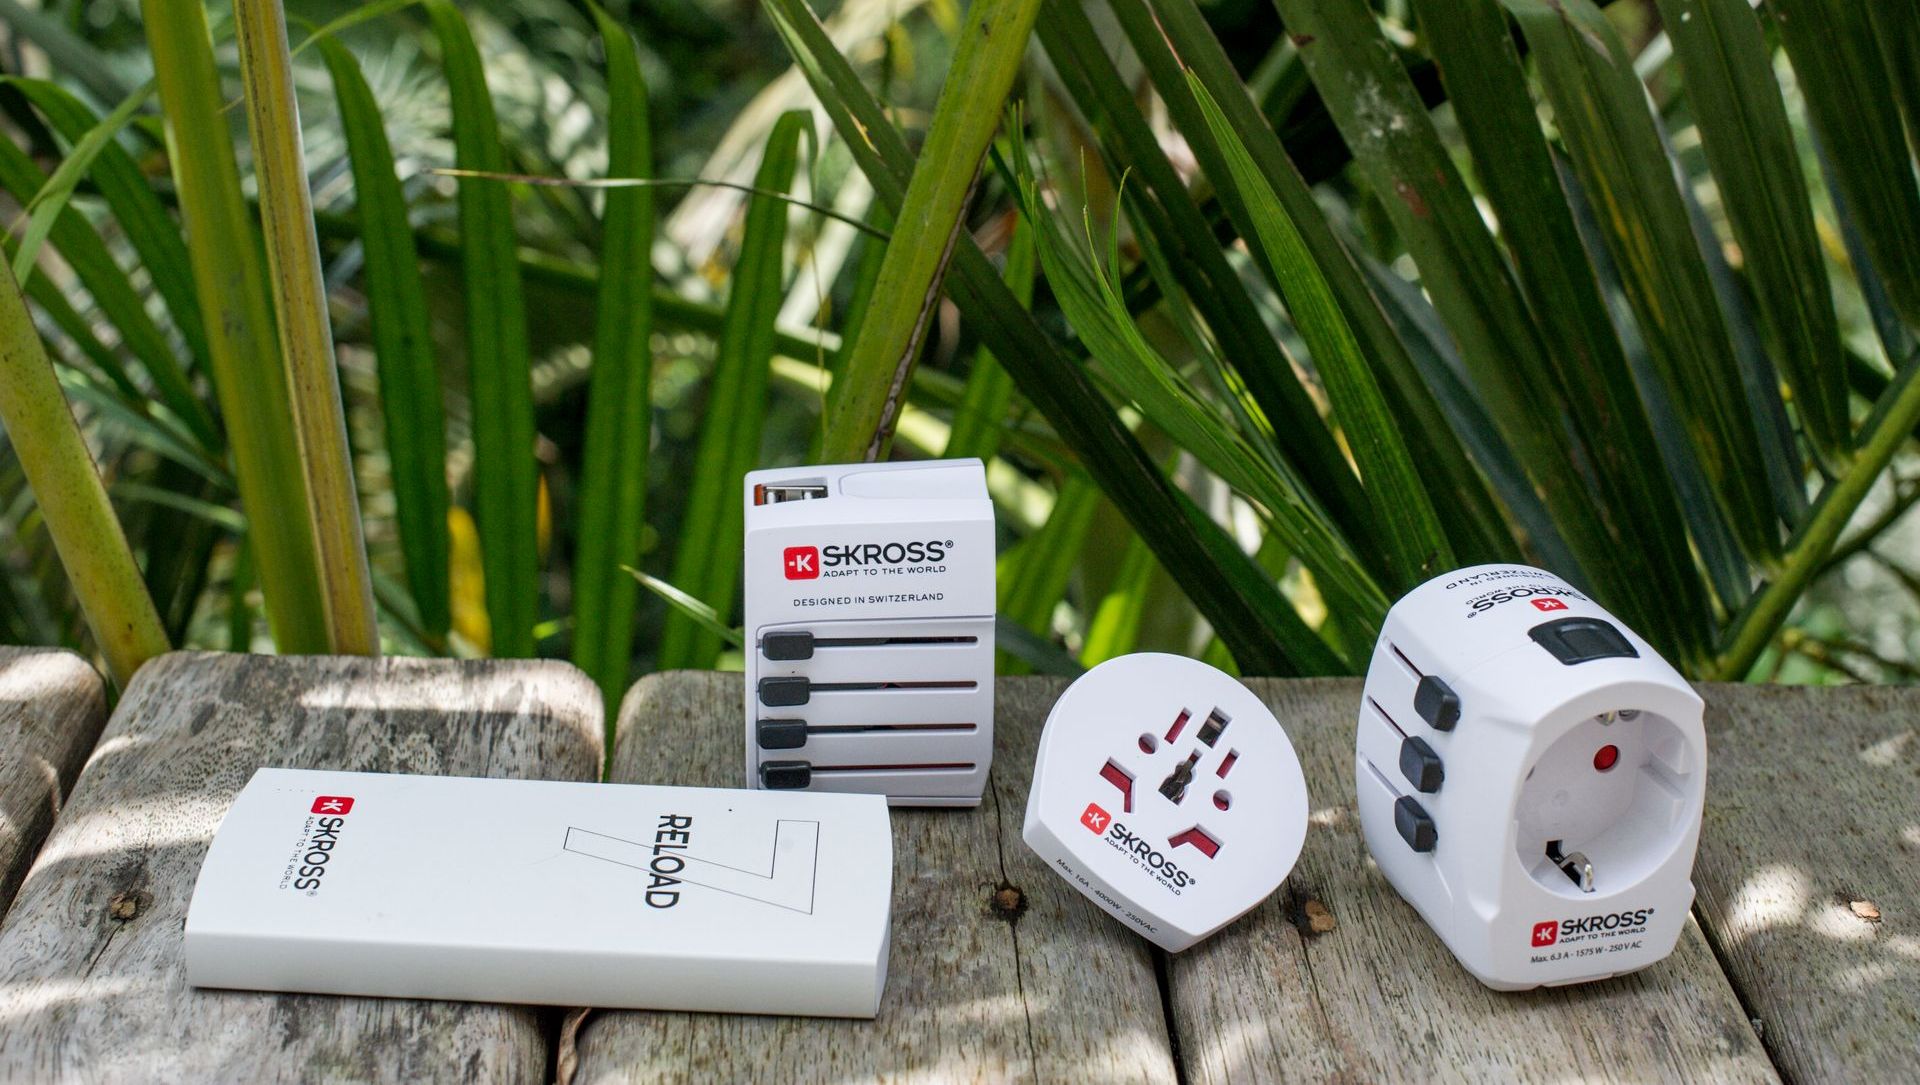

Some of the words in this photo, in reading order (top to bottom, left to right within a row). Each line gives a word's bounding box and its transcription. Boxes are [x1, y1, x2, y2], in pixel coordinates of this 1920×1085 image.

[823, 569, 859, 578] ADAPT
[863, 568, 878, 576] TO
[882, 567, 904, 575] THE
[907, 565, 947, 575] WORLD
[793, 597, 851, 607] DESIGNED
[855, 596, 865, 604] IN
[868, 593, 944, 604] SWITZERLAND
[1465, 589, 1504, 605] WORLD
[302, 816, 315, 836] ADAPT
[296, 838, 307, 848] TO
[290, 850, 302, 862] THE
[645, 814, 693, 909] RELOAD
[1104, 836, 1128, 856] ADAPT
[1129, 855, 1139, 865] TO
[1140, 864, 1156, 877] THE
[1156, 875, 1182, 896] WORLD
[279, 864, 295, 890] WORLD
[1056, 858, 1073, 875] Max.
[1075, 874, 1089, 888] 16A
[1094, 889, 1122, 910] 4000W
[1125, 911, 1159, 934] 250VAC
[1559, 935, 1585, 944] ADAPT
[1618, 927, 1646, 936] WORLD
[1550, 952, 1562, 961] 6.3
[1576, 947, 1594, 957] 1575
[1594, 946, 1604, 954] W
[1608, 943, 1624, 953] 250
[1630, 940, 1643, 949] AC
